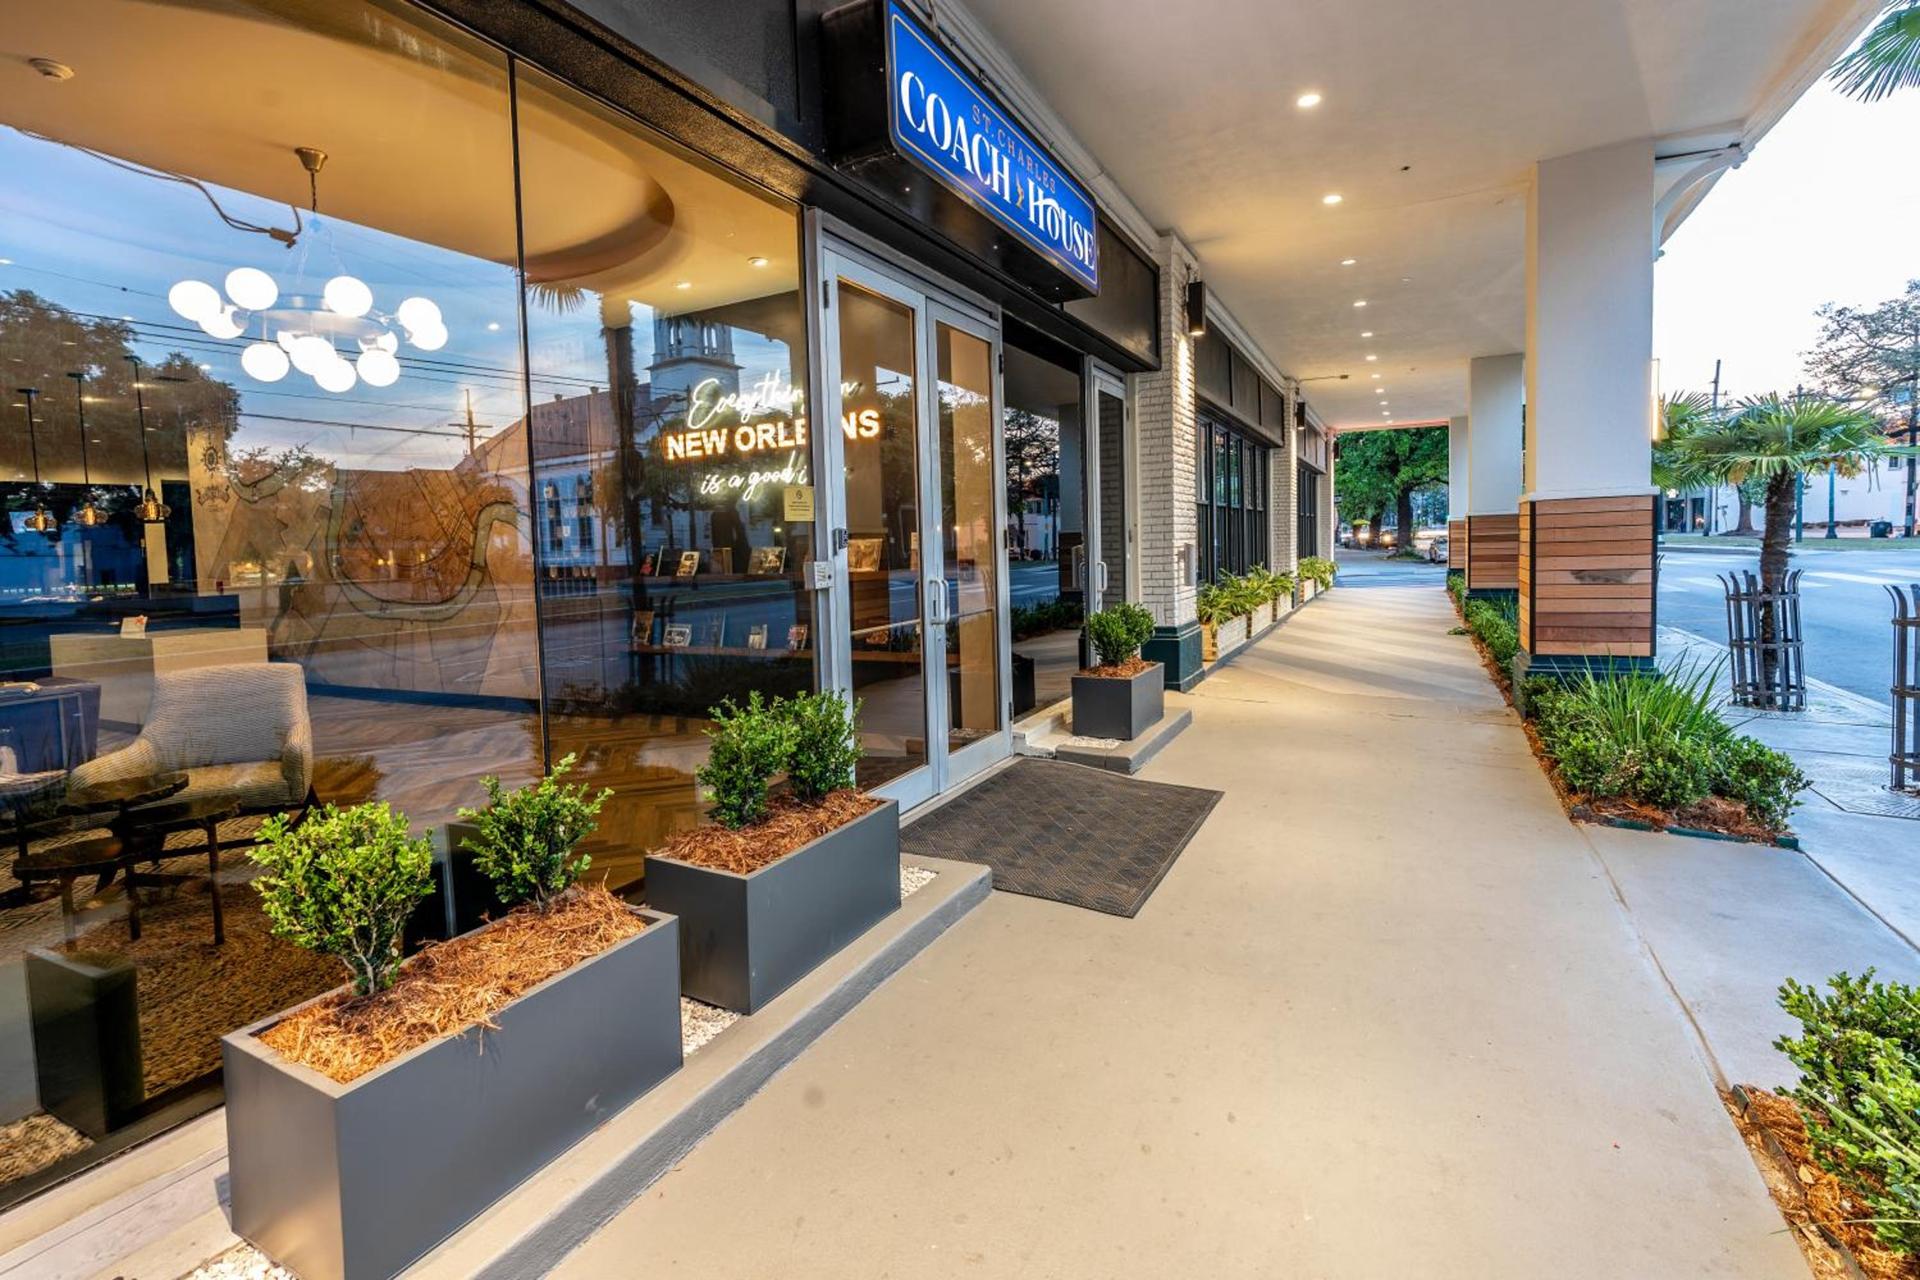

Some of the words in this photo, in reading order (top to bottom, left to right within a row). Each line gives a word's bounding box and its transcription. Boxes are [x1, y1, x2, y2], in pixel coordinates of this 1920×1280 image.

[900, 71, 1012, 204] COACH
[1027, 177, 1095, 271] HOUSE
[972, 104, 995, 138] ST.
[998, 128, 1055, 194] CHARLES
[687, 368, 805, 429] Everythin
[666, 427, 729, 461] NEW
[734, 409, 880, 452] ORLENS
[700, 473, 725, 495] is
[728, 474, 745, 488] a
[742, 449, 797, 501] good
